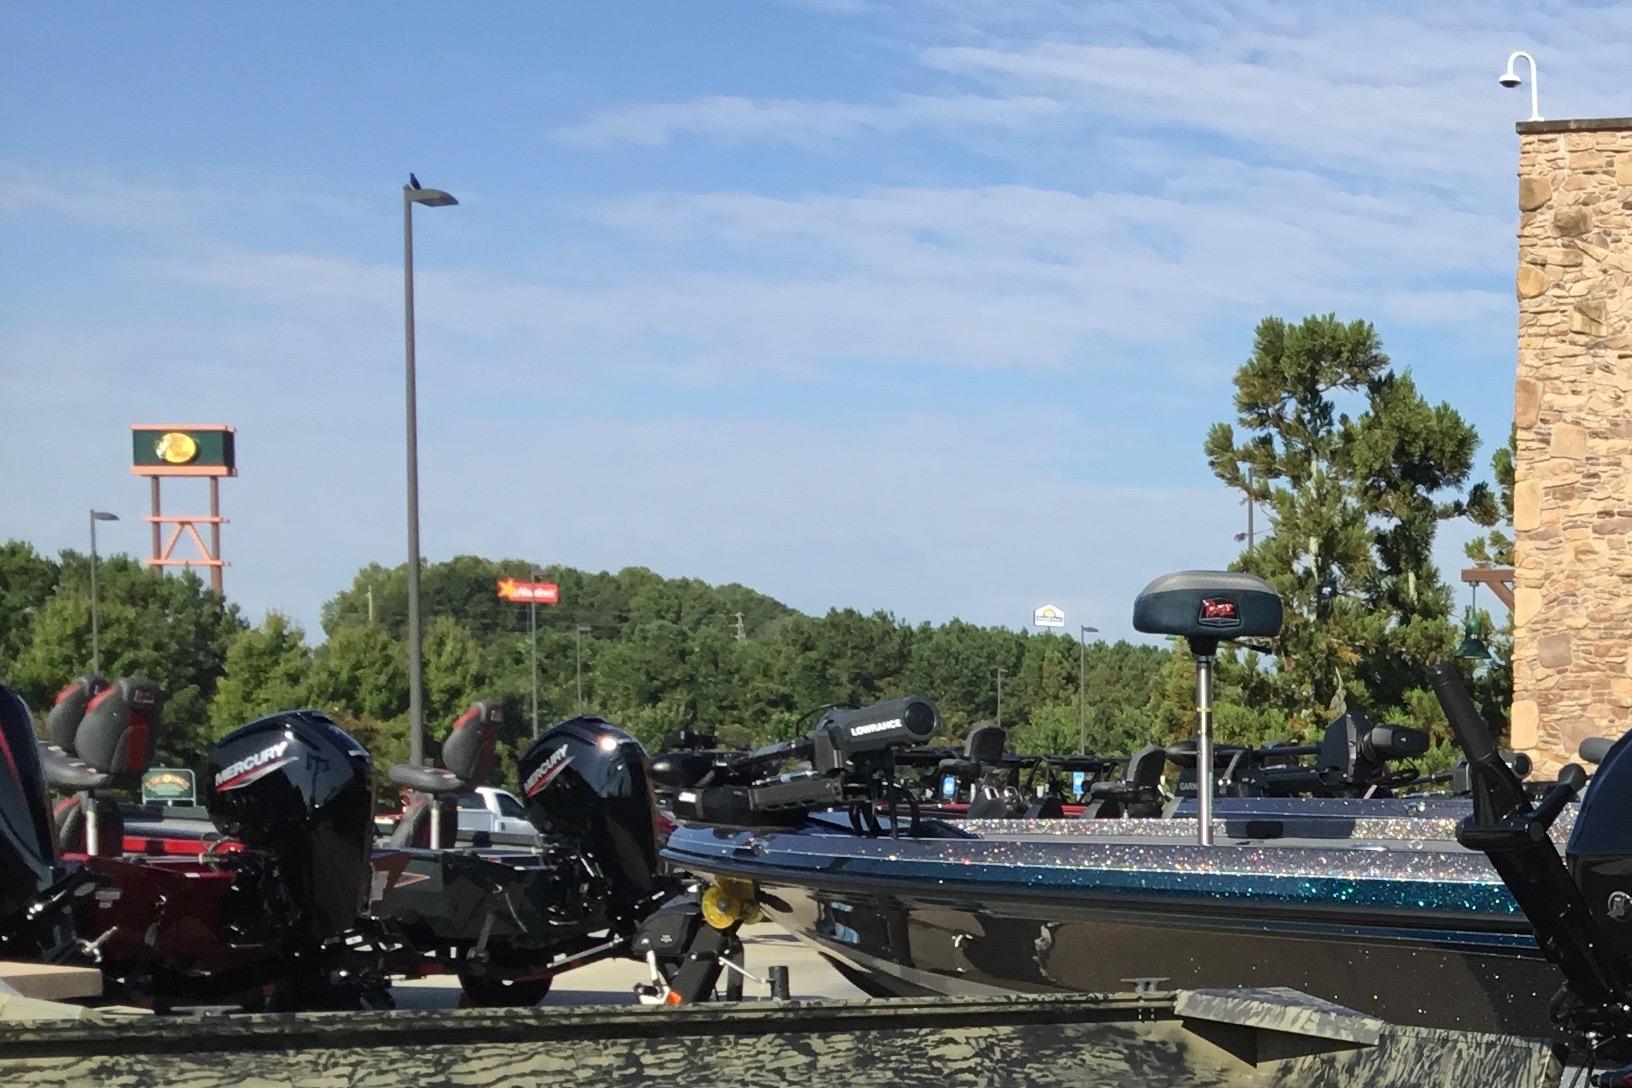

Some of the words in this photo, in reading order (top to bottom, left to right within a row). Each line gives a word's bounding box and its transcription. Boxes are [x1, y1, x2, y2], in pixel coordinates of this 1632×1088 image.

[850, 718, 902, 736] LOWRANCE
[215, 741, 288, 786] MERCURY
[524, 744, 568, 793] MERCURY
